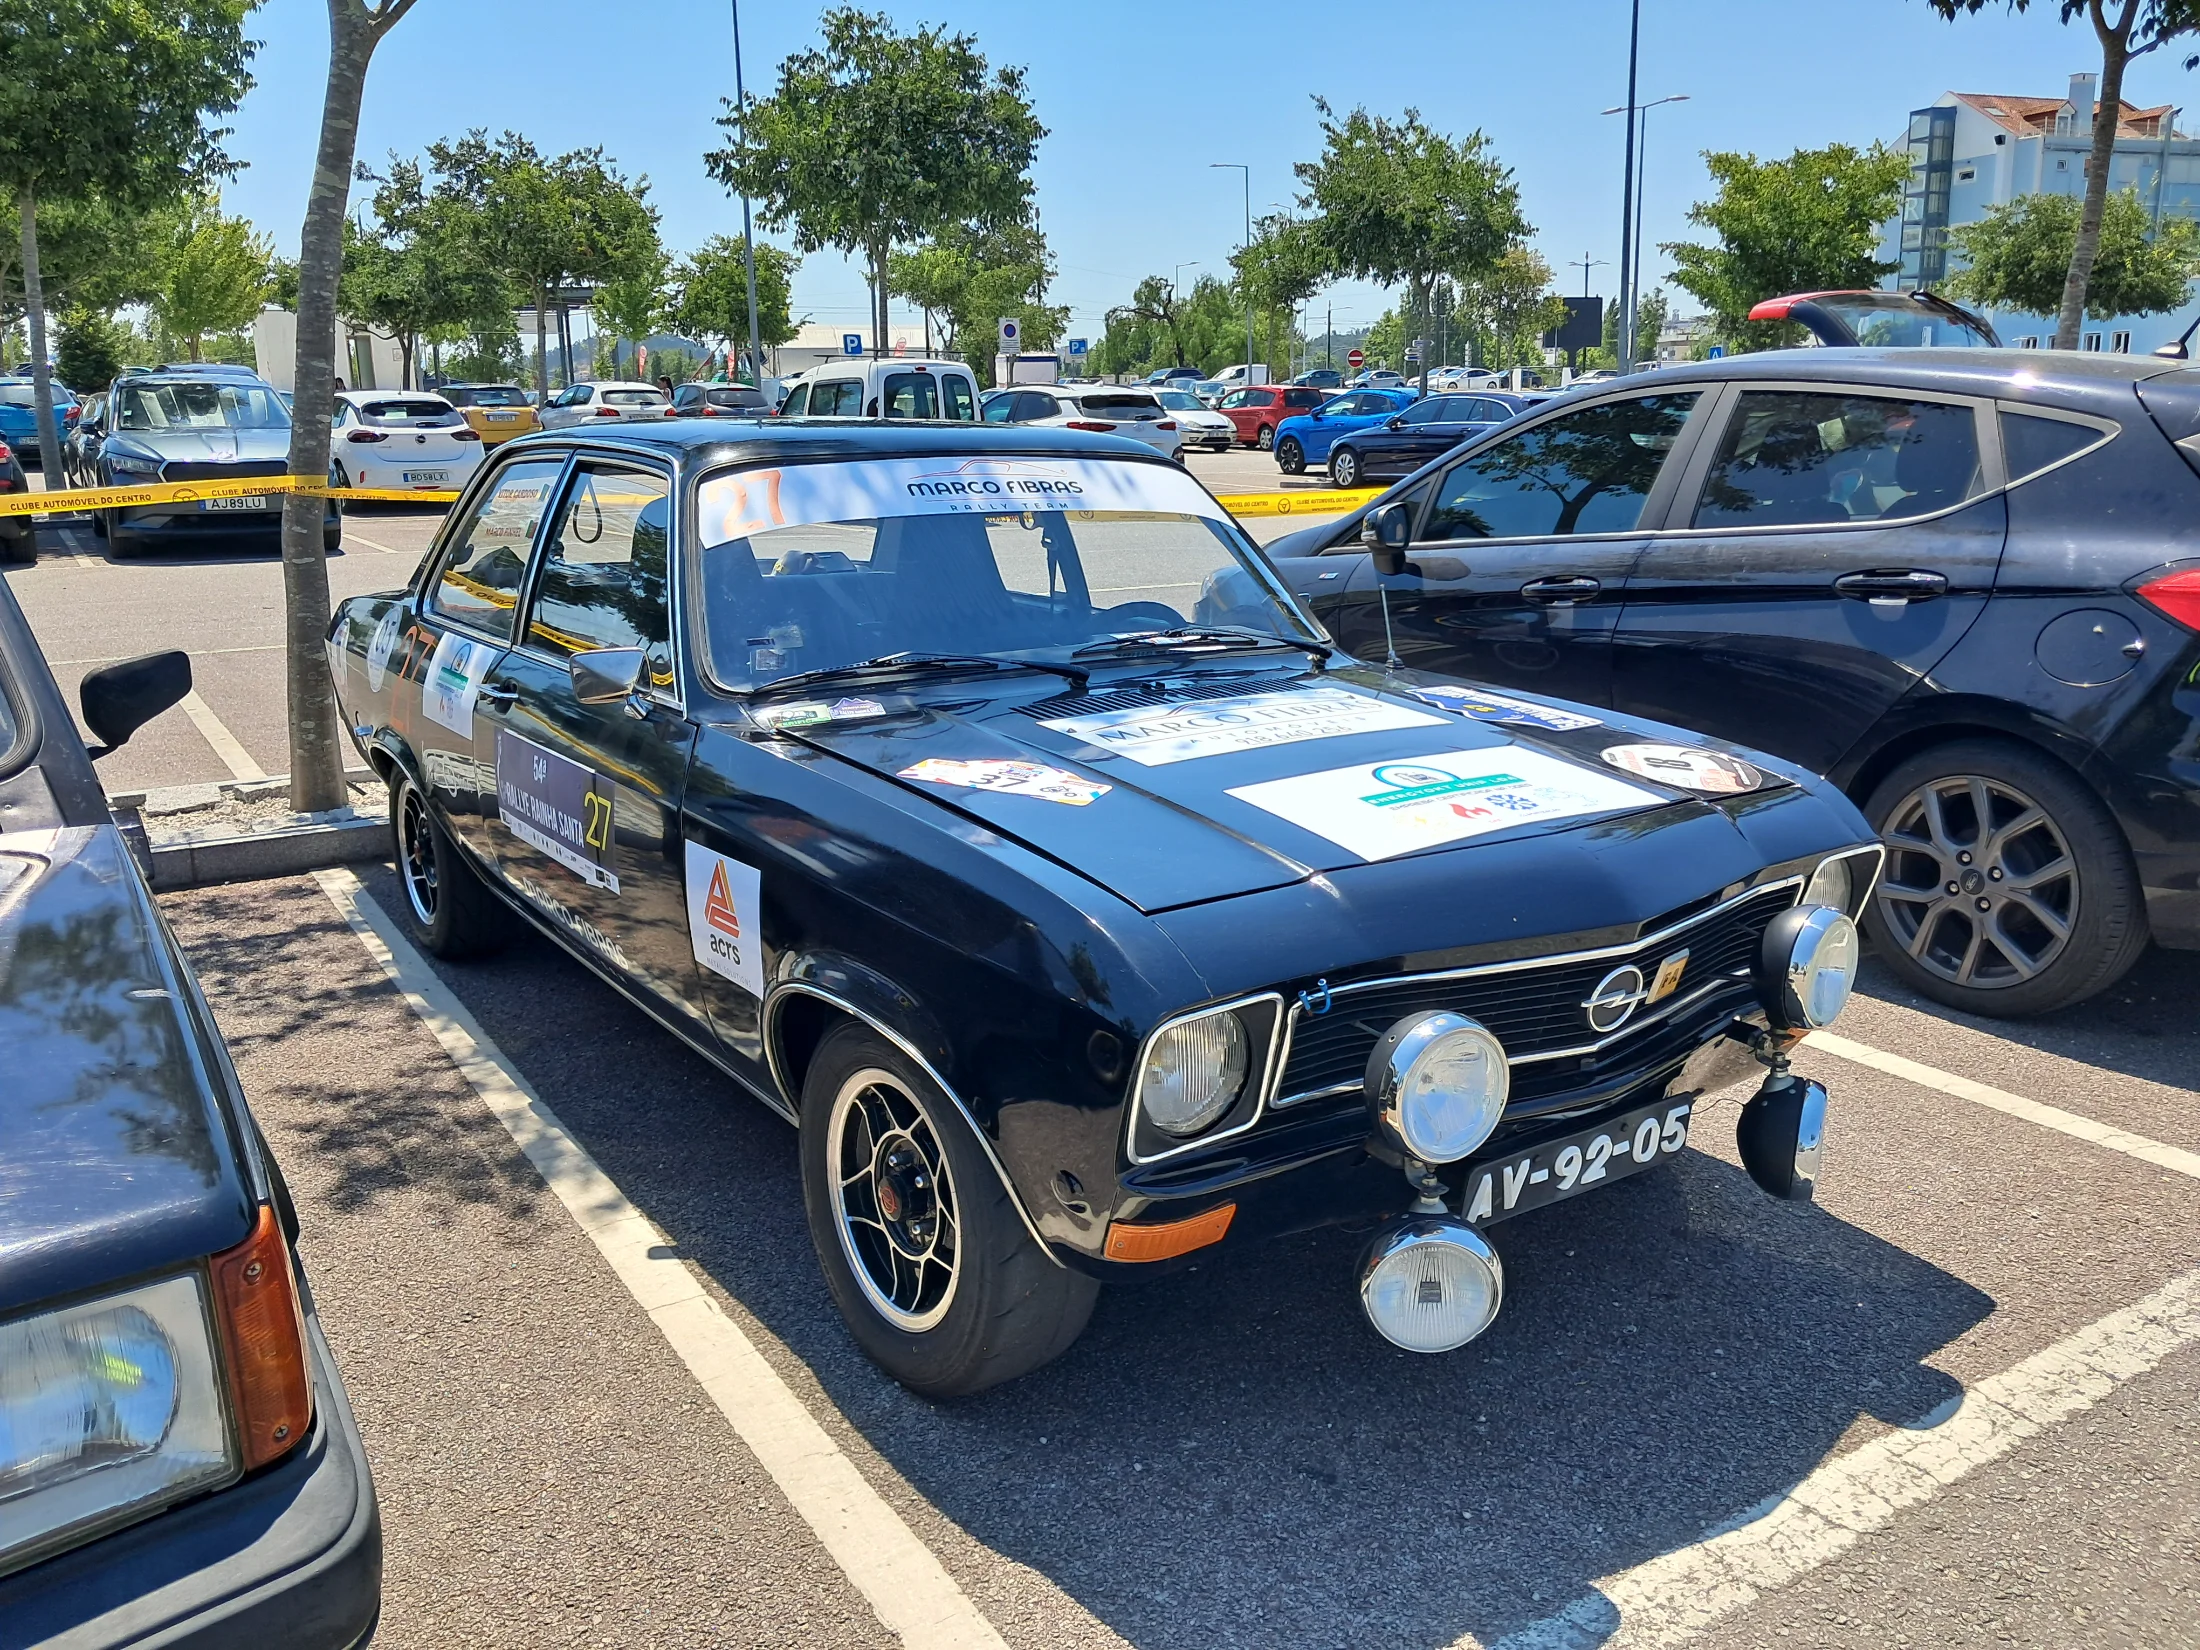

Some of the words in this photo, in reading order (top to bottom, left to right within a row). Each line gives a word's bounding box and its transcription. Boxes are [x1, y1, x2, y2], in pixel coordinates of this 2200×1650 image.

[846, 335, 859, 353] P
[211, 488, 240, 498] CLUBE
[906, 480, 1001, 497] MARCO
[1006, 480, 1084, 494] FIBRAS
[9, 502, 40, 511] CLUBE
[43, 497, 99, 509] AUTOMÓVEL
[100, 495, 114, 505] DO
[115, 492, 152, 504] CENTRO
[210, 497, 262, 509] AJ89LU
[705, 469, 786, 539] 27
[949, 503, 1009, 512] RALLY
[1022, 502, 1069, 510] TEAM
[1095, 713, 1251, 744] MARCO
[1254, 699, 1383, 720] FIBRAS
[968, 772, 1031, 788] 37
[507, 781, 531, 818] RALLYE
[530, 794, 558, 833] RAINHA
[557, 808, 585, 849] SANTA
[584, 791, 612, 852] 27
[709, 933, 742, 966] acrs
